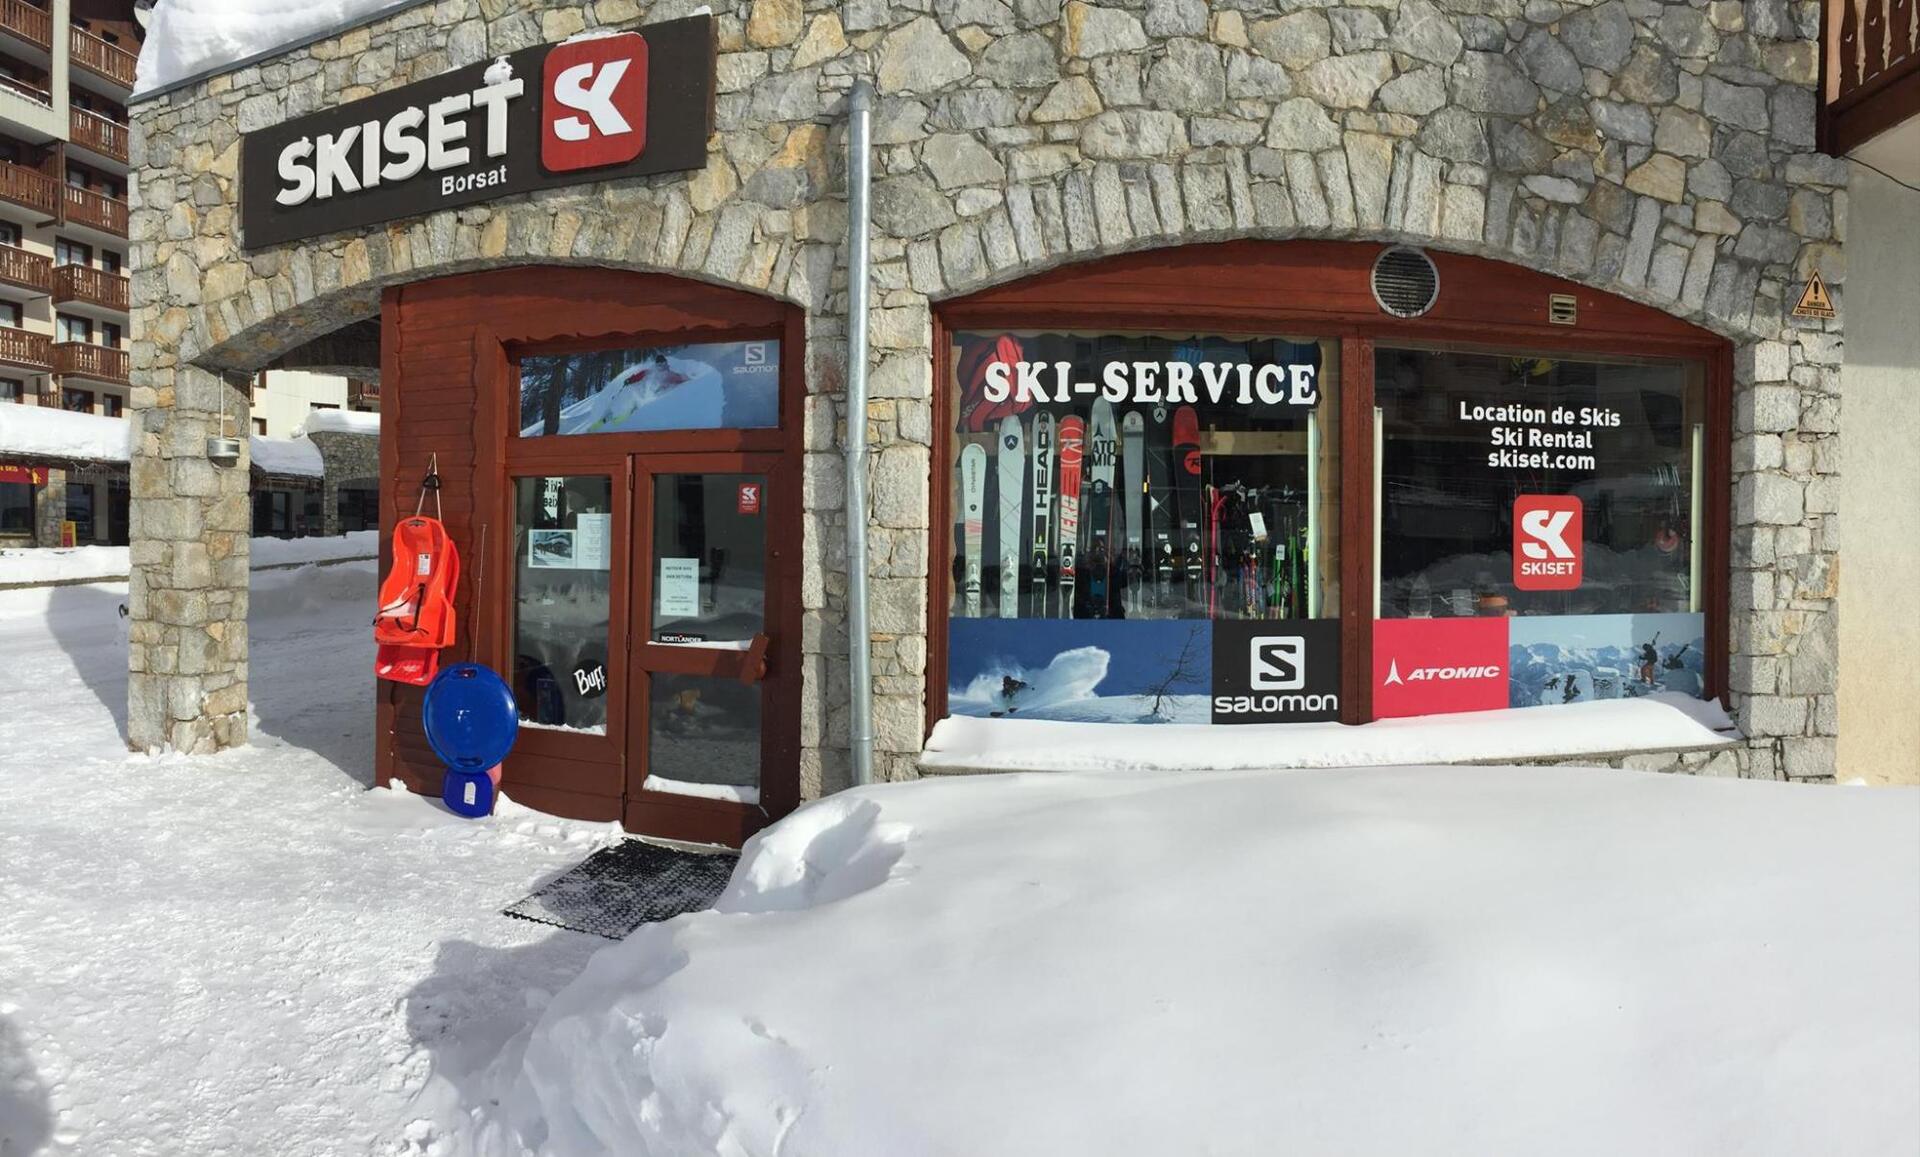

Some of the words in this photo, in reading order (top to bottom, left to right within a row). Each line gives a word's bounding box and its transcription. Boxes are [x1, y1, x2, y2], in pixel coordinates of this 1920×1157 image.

[275, 78, 524, 206] SKISET
[442, 167, 507, 196] Borsat
[733, 365, 777, 374] salomon
[984, 361, 1317, 405] SKI-SERVICE
[1460, 401, 1546, 424] Location
[1551, 406, 1575, 425] de
[1579, 407, 1621, 427] Skis
[1490, 427, 1523, 446] Ski
[1529, 428, 1593, 449] Rental
[1036, 431, 1049, 508] HEAD
[1488, 449, 1596, 470] skiset.com
[1521, 562, 1576, 576] SKISET
[1407, 666, 1500, 681] ATOMIC
[1215, 694, 1338, 714] salomon
